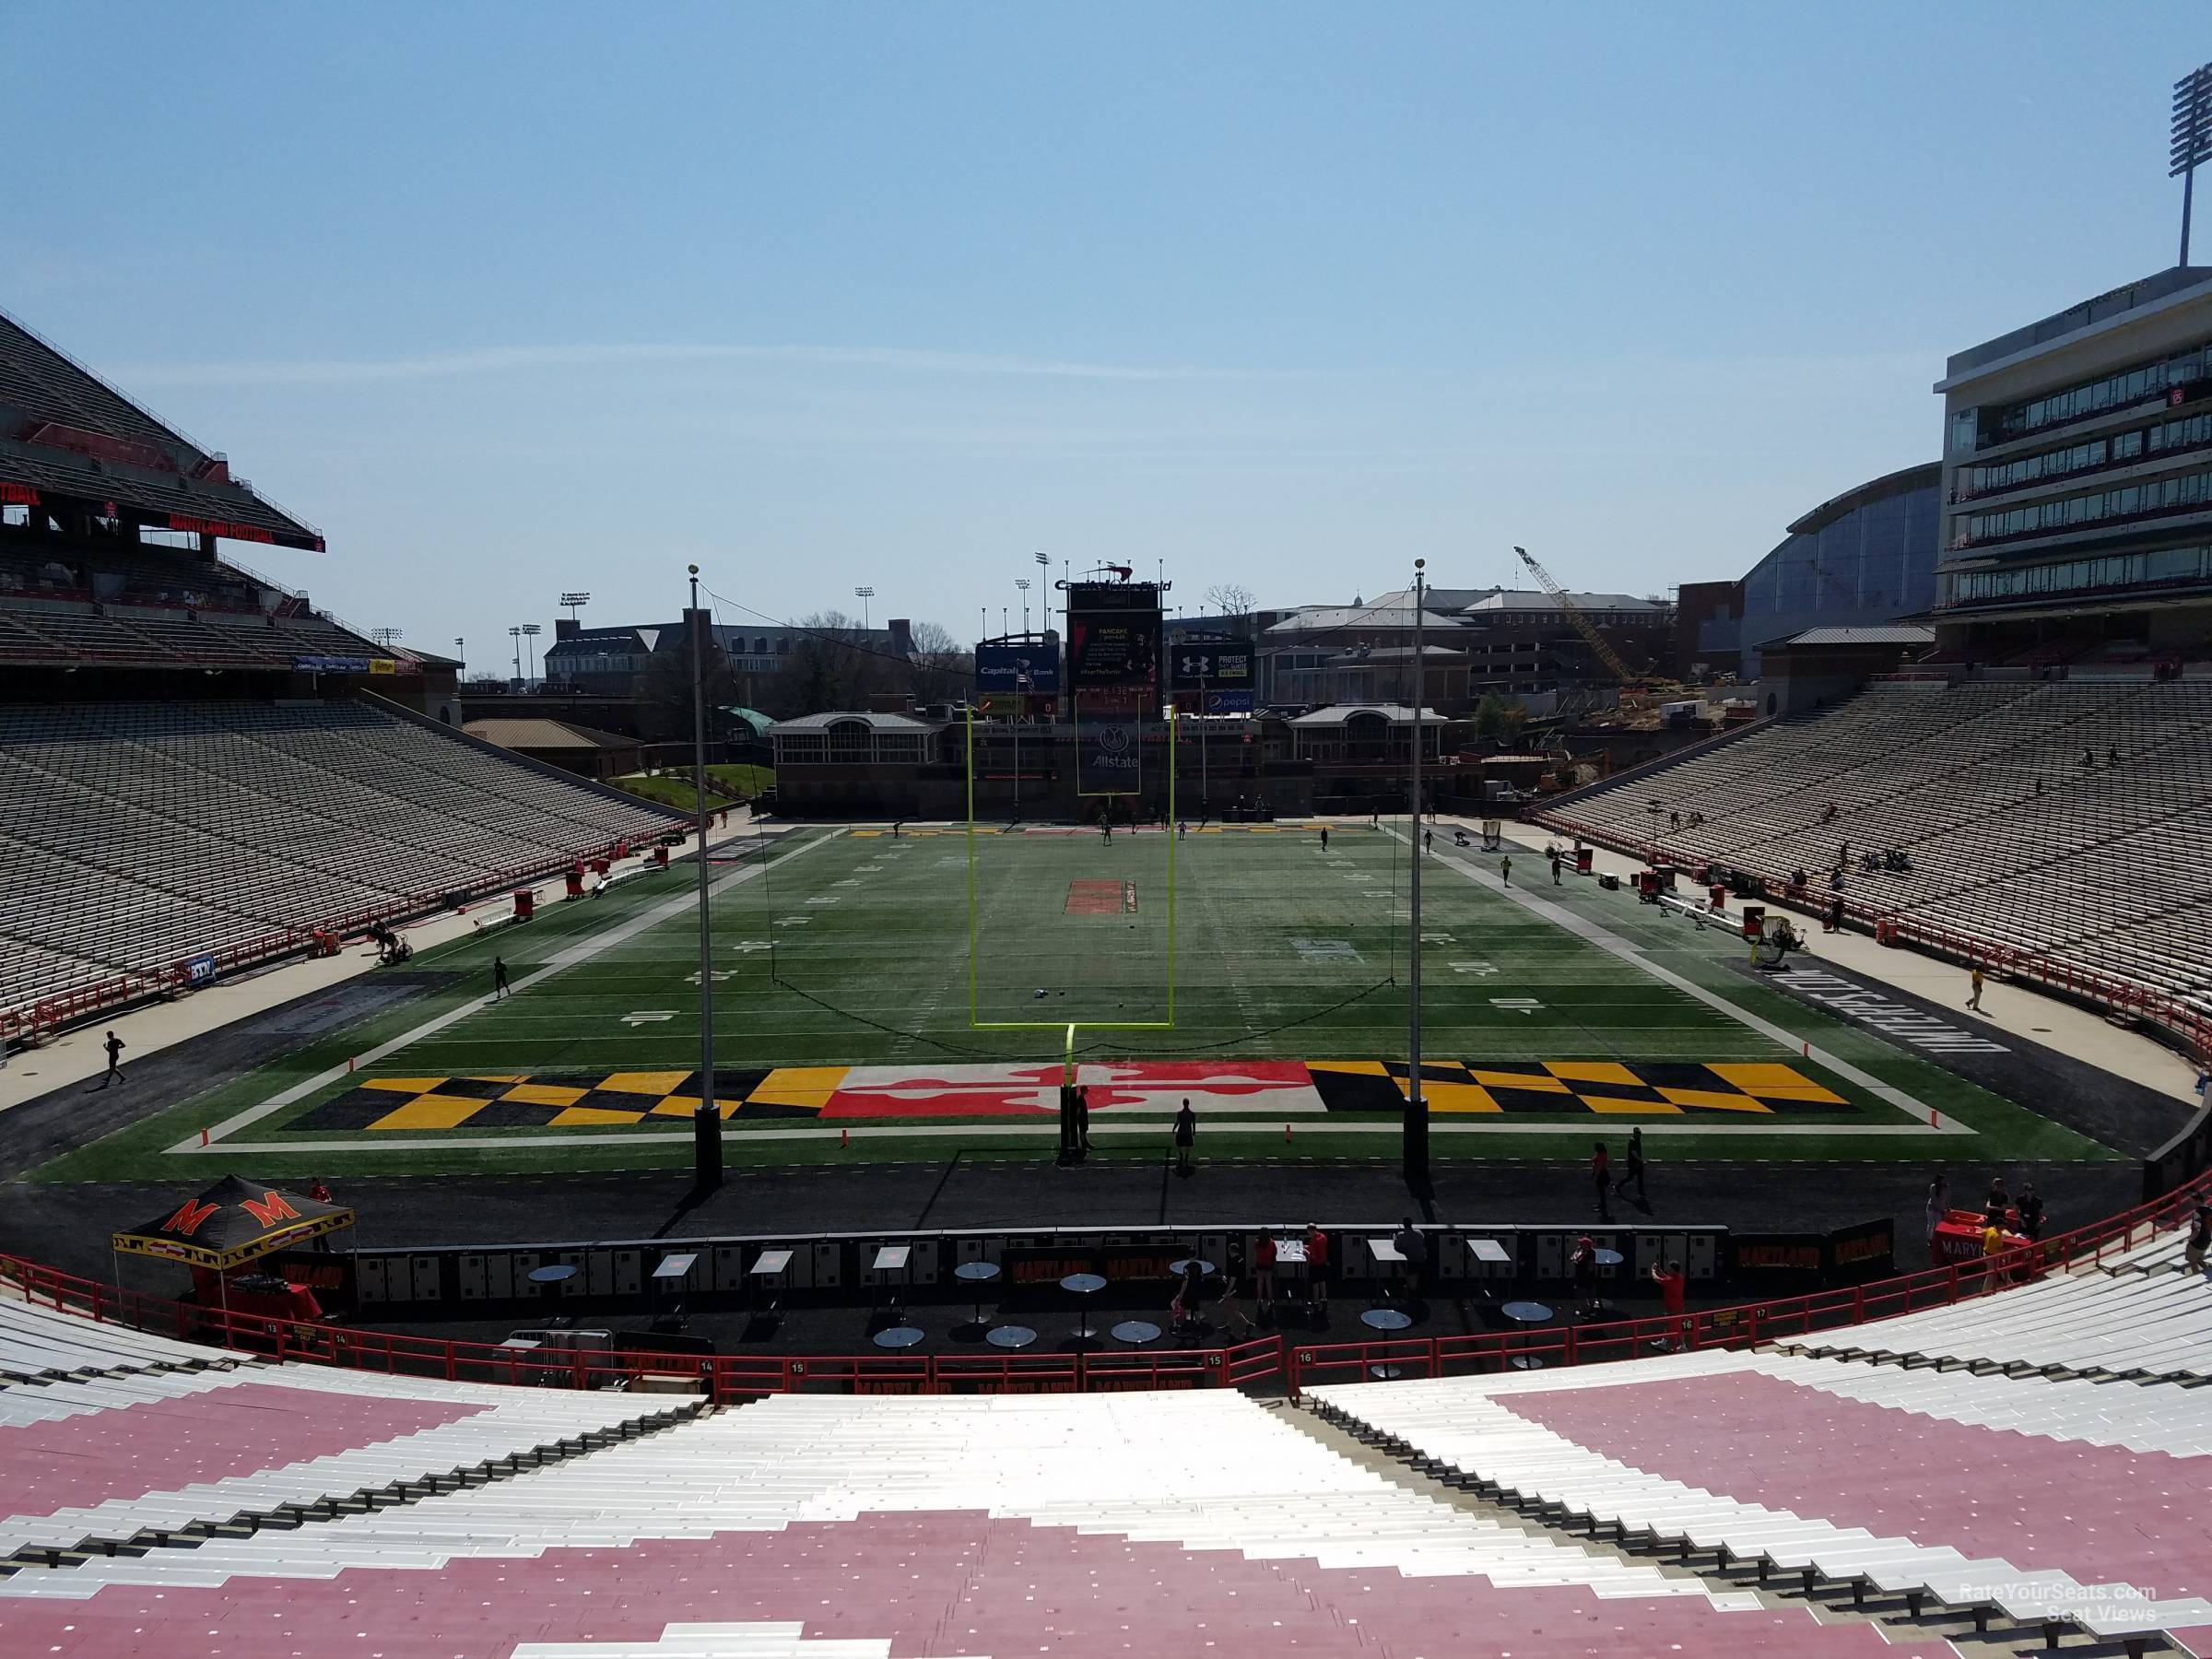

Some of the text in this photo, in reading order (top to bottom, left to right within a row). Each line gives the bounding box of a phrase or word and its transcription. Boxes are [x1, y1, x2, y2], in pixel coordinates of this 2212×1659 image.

[980, 665, 1016, 677] Capital
[1223, 698, 1250, 708] pepsi
[1092, 755, 1138, 768] Allstate
[191, 960, 211, 980] BTN
[239, 1191, 302, 1229] M
[160, 1198, 221, 1236] M
[1208, 1356, 1220, 1366] 15
[1300, 1352, 1311, 1363] 16
[700, 1361, 713, 1372] 14
[791, 1362, 804, 1373] 15
